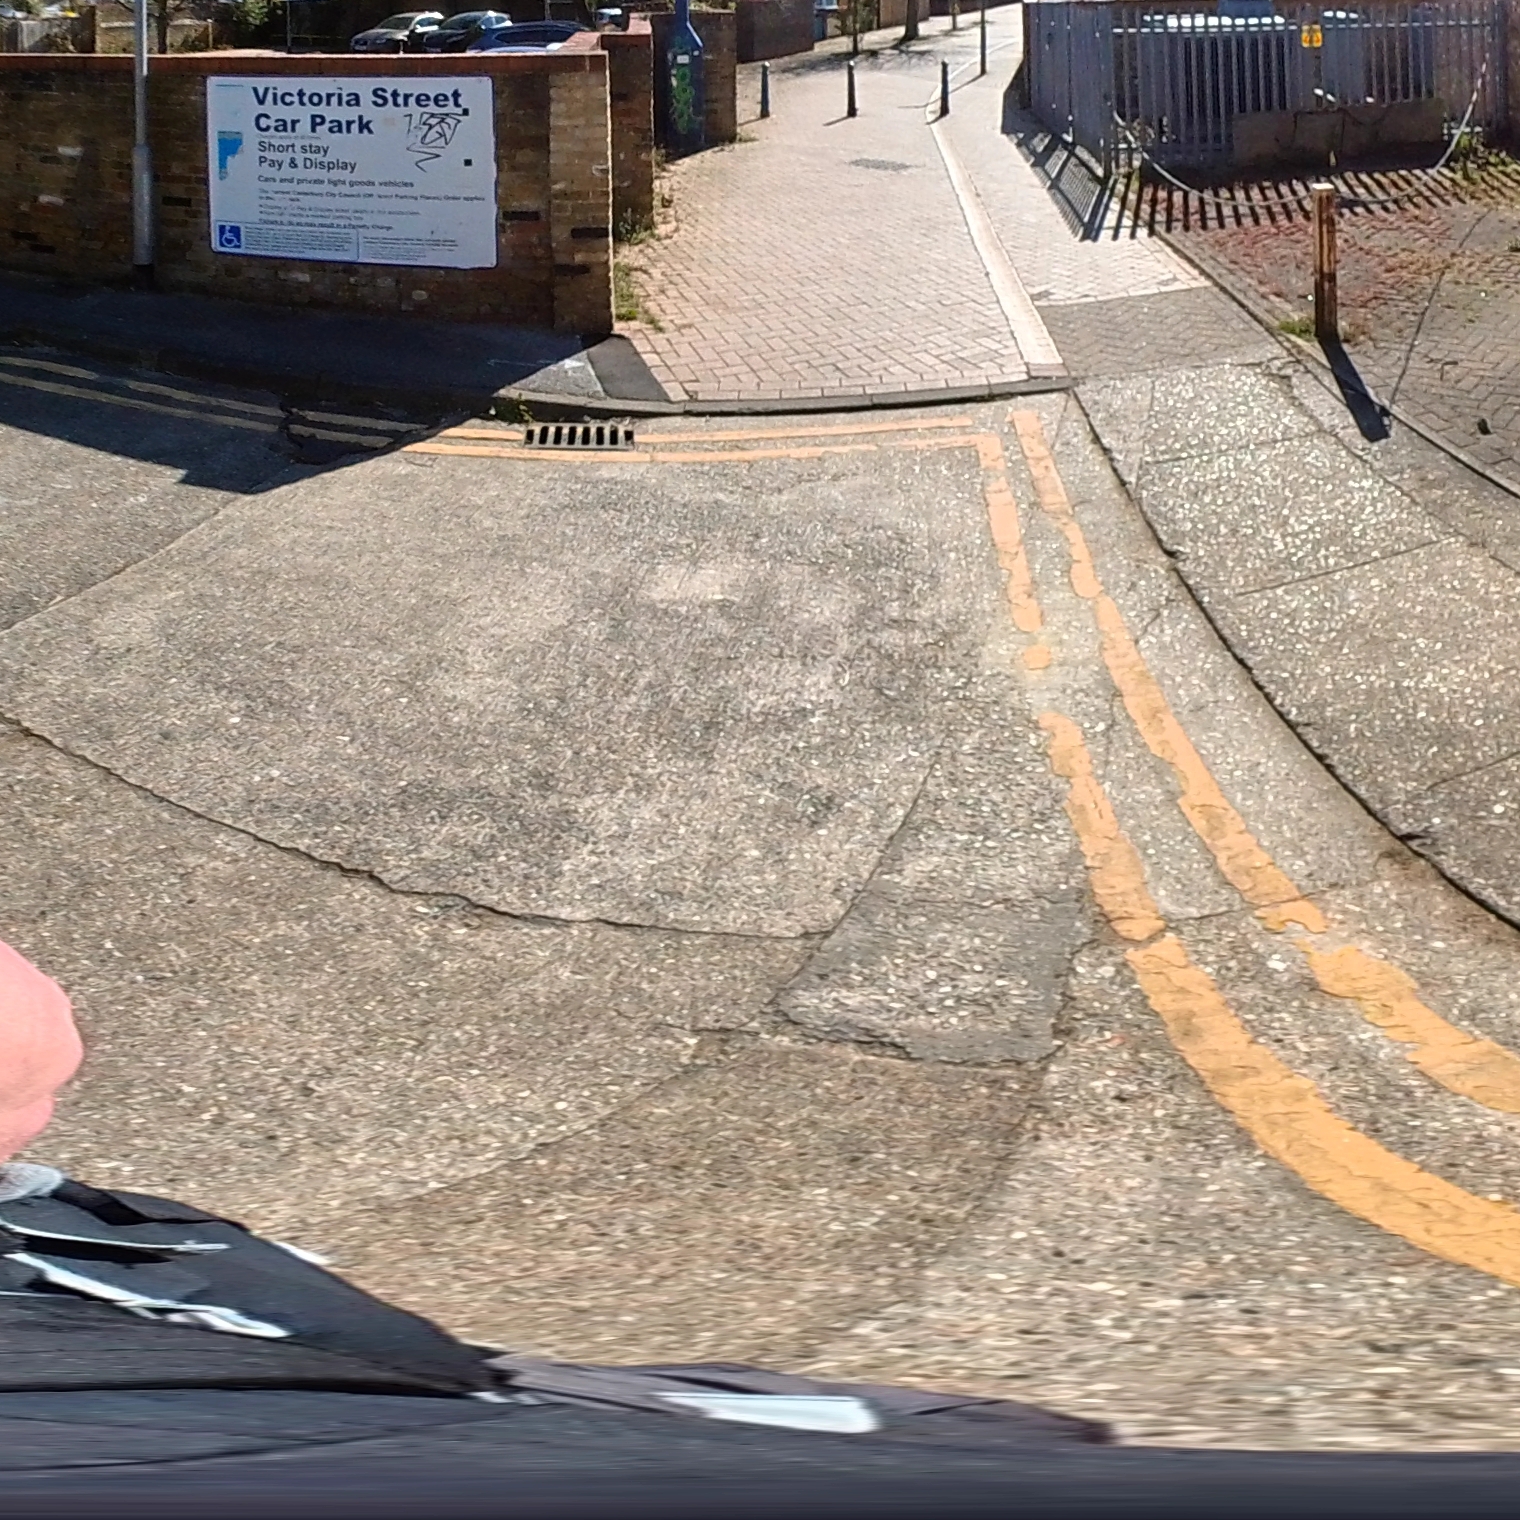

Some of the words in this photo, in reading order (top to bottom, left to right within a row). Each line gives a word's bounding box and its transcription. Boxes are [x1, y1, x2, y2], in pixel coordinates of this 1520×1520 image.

[252, 86, 361, 107] Victoria
[371, 87, 462, 108] Street
[255, 113, 300, 133] Car
[310, 114, 374, 135] Park
[258, 141, 296, 153] Short
[300, 143, 330, 157] stay
[258, 156, 284, 171] Pay
[288, 157, 298, 169] &
[303, 157, 357, 174] Display
[257, 175, 277, 183] Cars
[297, 177, 325, 185] private
[348, 179, 375, 188] goods
[378, 179, 414, 188] vehicles
